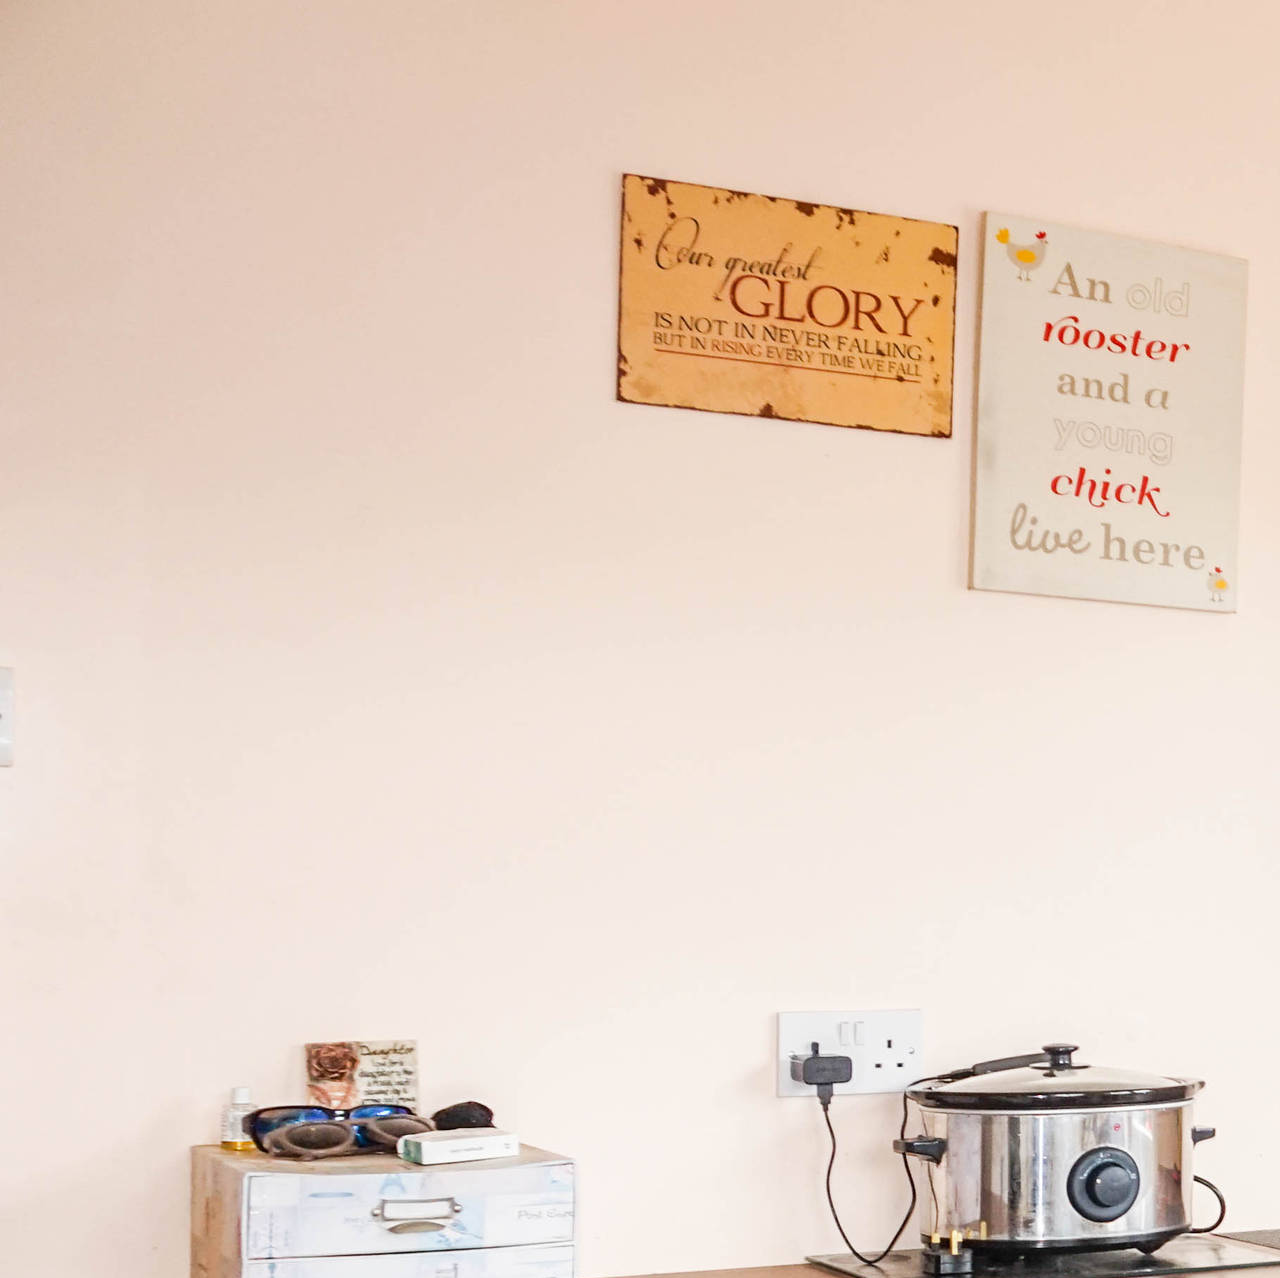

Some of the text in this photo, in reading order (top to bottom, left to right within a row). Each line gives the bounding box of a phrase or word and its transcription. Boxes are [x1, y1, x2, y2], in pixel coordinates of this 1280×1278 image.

[655, 216, 823, 301] Our greatest
[729, 274, 925, 337] GLORY
[1048, 261, 1191, 318] An old
[653, 331, 922, 376] BUT IN RISING EVERY TIME WE FALL
[654, 311, 922, 361] IS NOT IN NEVER FALLING
[1042, 315, 1191, 363] rooster
[1056, 372, 1170, 411] and a
[1053, 417, 1175, 467] young
[1050, 466, 1171, 518] chick
[1009, 502, 1206, 572] live here
